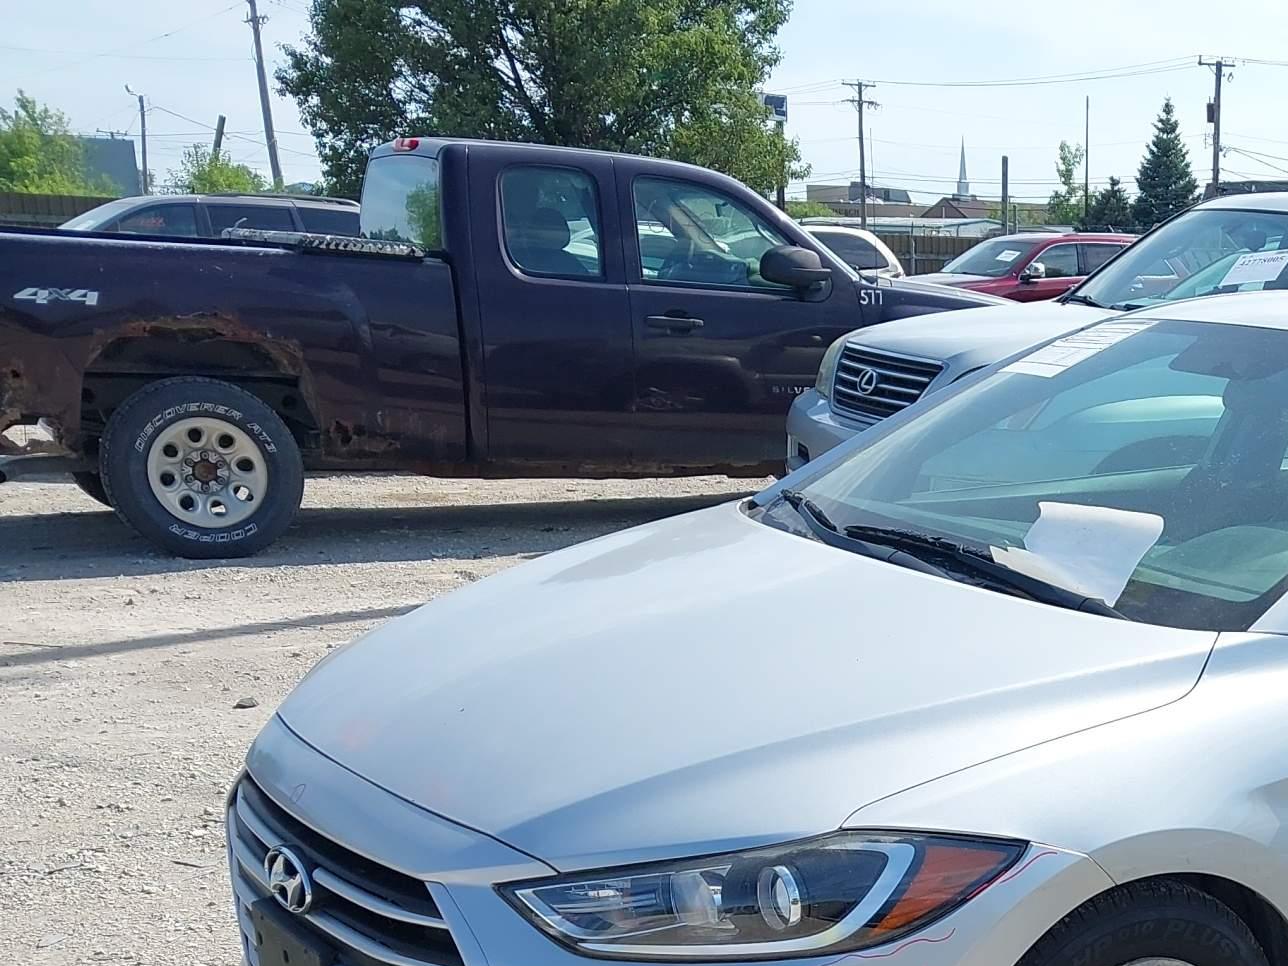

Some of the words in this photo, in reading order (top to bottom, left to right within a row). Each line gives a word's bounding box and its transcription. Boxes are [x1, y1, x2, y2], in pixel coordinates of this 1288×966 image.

[859, 289, 883, 305] 577
[134, 402, 243, 453] DISCOVERER
[168, 522, 258, 543] COOPER
